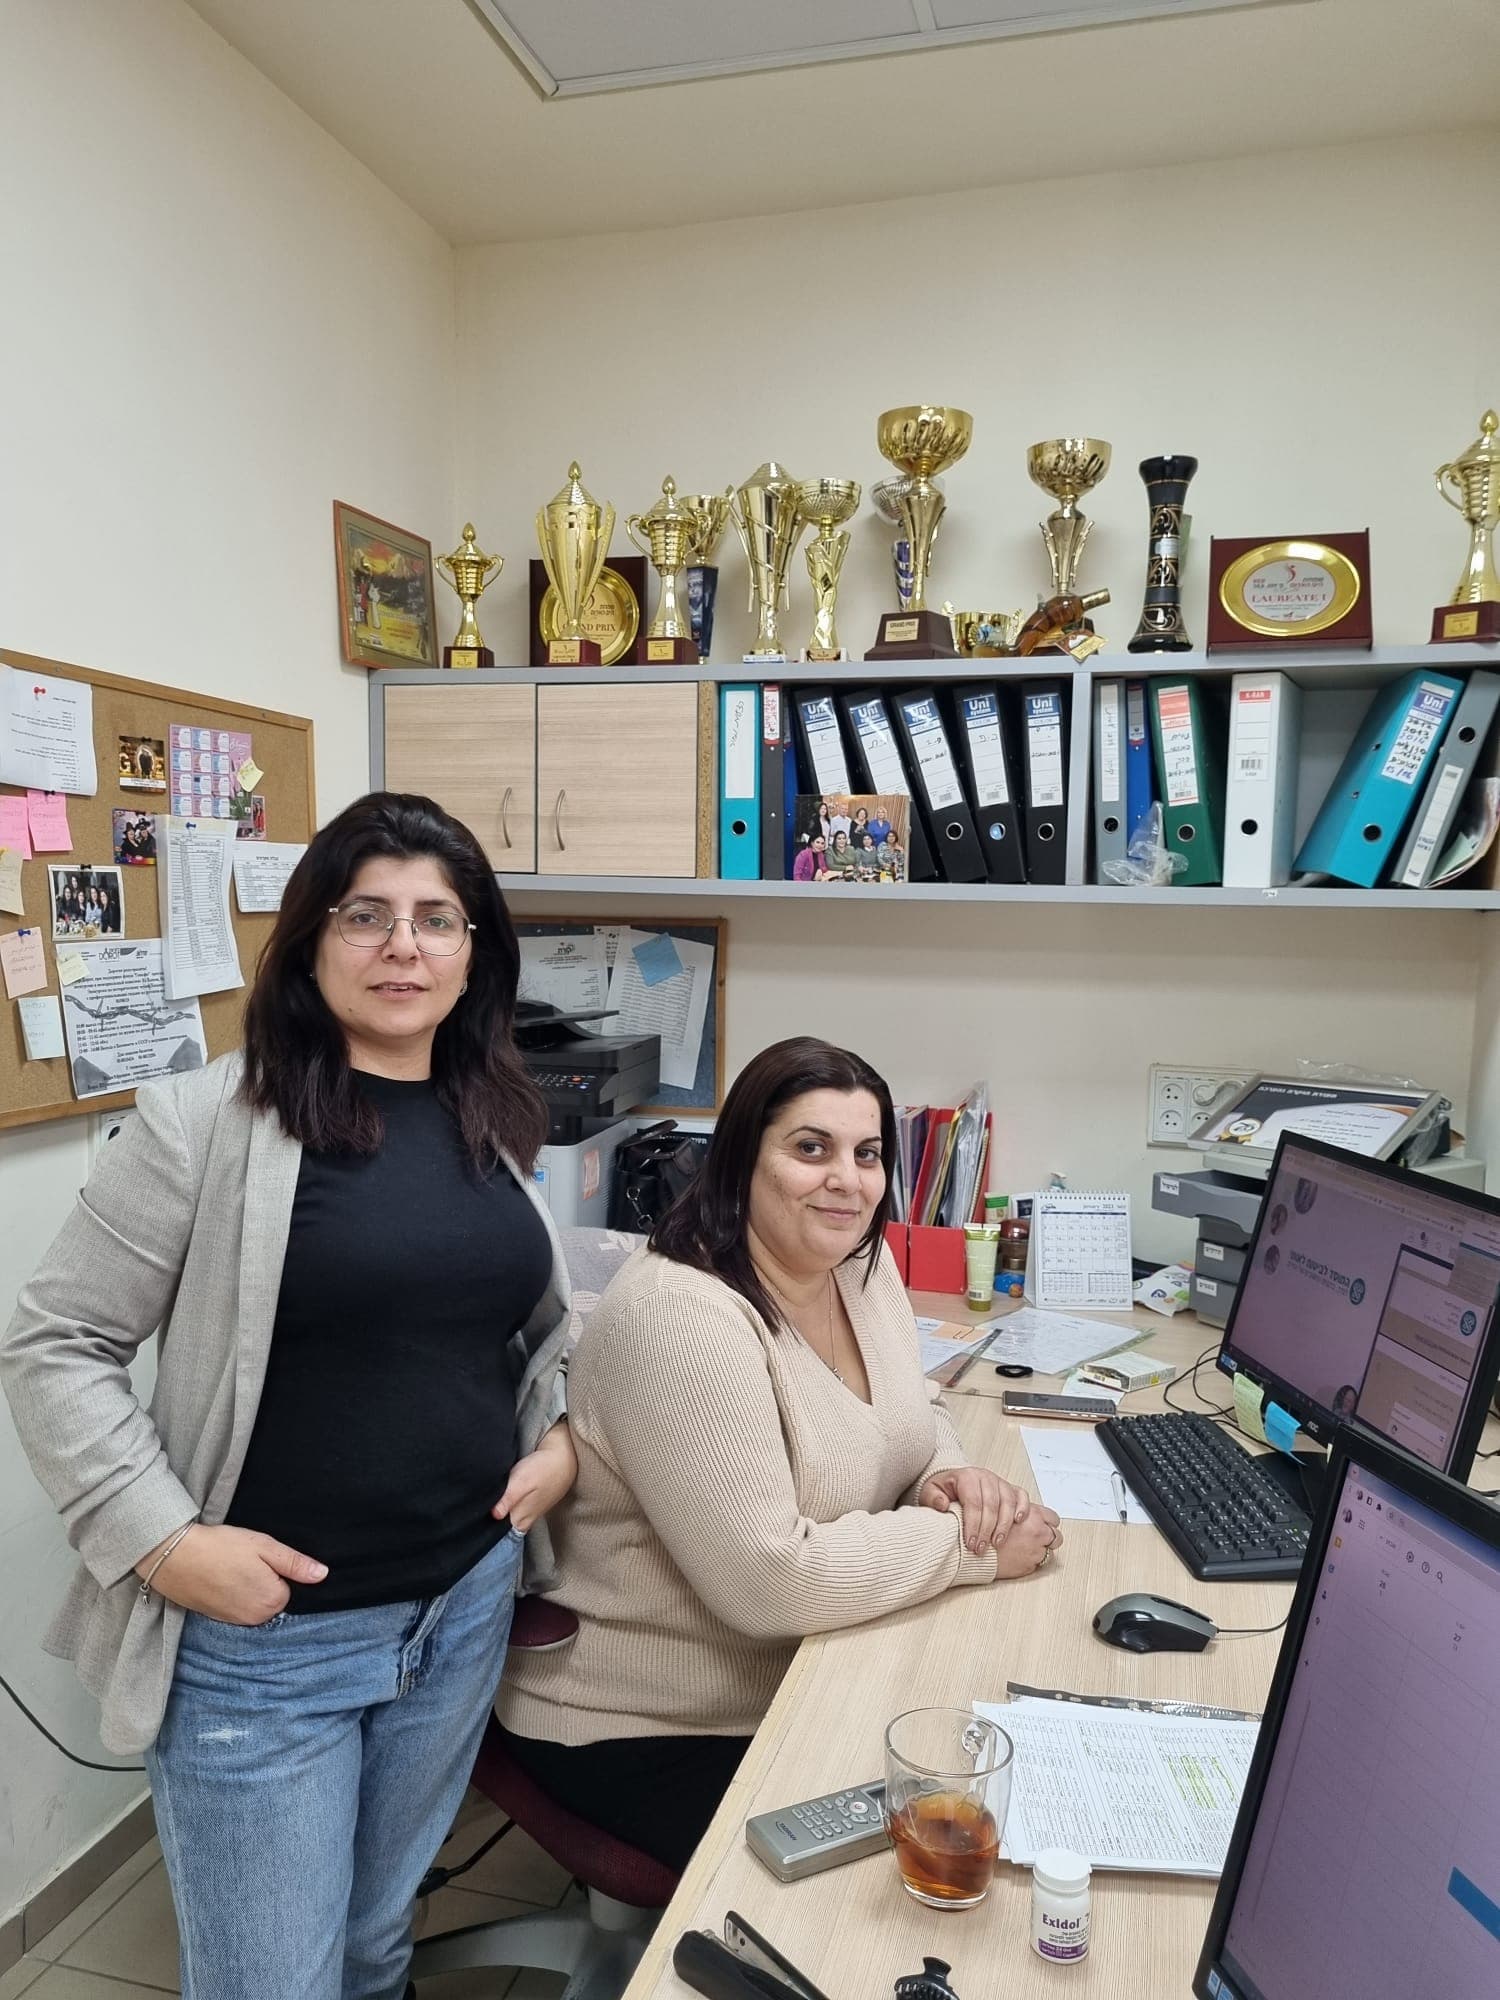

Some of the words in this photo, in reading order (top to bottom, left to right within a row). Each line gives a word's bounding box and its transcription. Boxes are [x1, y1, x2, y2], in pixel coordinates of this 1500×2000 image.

[1252, 594, 1318, 603] LAUREATE
[595, 623, 617, 632] PRIX
[969, 697, 990, 711] Uni
[1032, 696, 1052, 709] Uni
[1424, 694, 1445, 709] Uni
